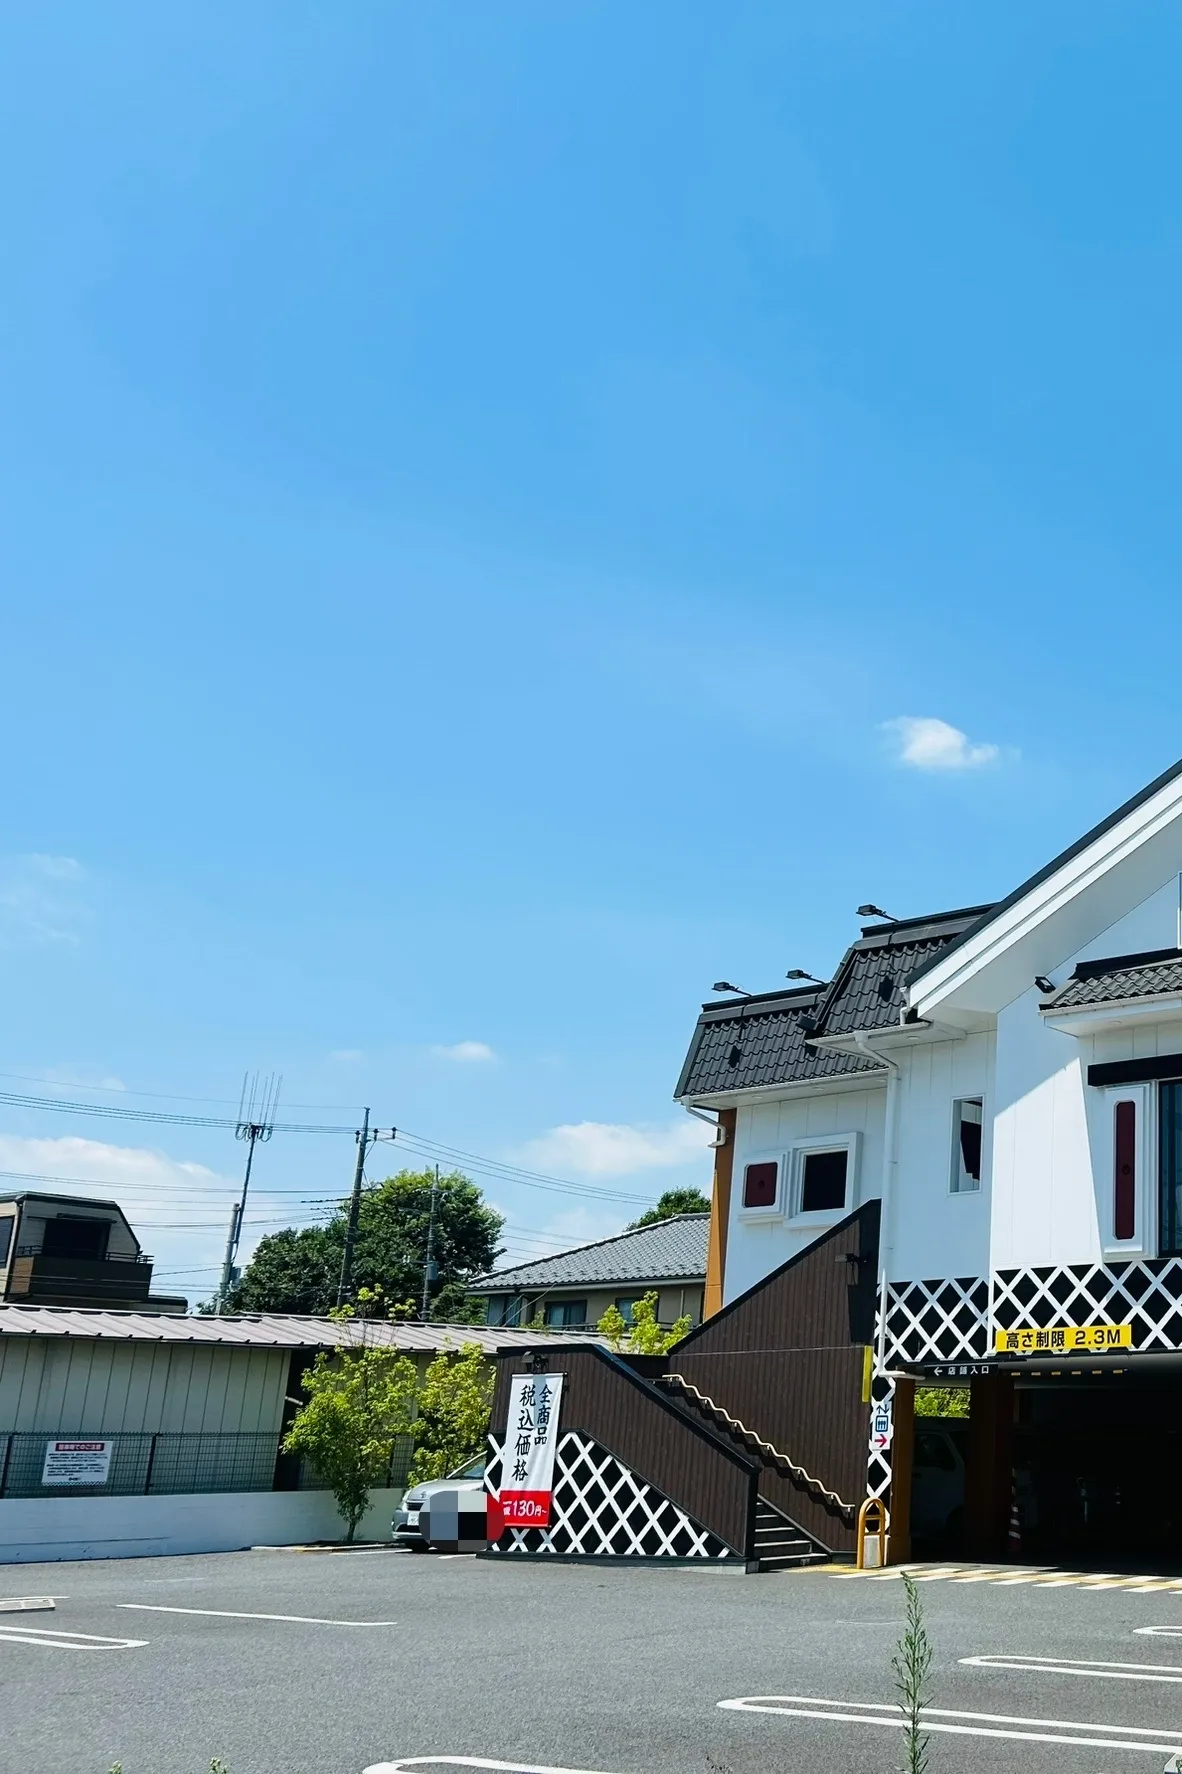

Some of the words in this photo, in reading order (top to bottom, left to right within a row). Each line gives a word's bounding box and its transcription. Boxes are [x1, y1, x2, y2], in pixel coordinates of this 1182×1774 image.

[1006, 1331, 1065, 1350] 高さ制限
[1075, 1329, 1121, 1346] 2.3M
[511, 1384, 537, 1482] 税込価格
[534, 1384, 553, 1446] 全商品
